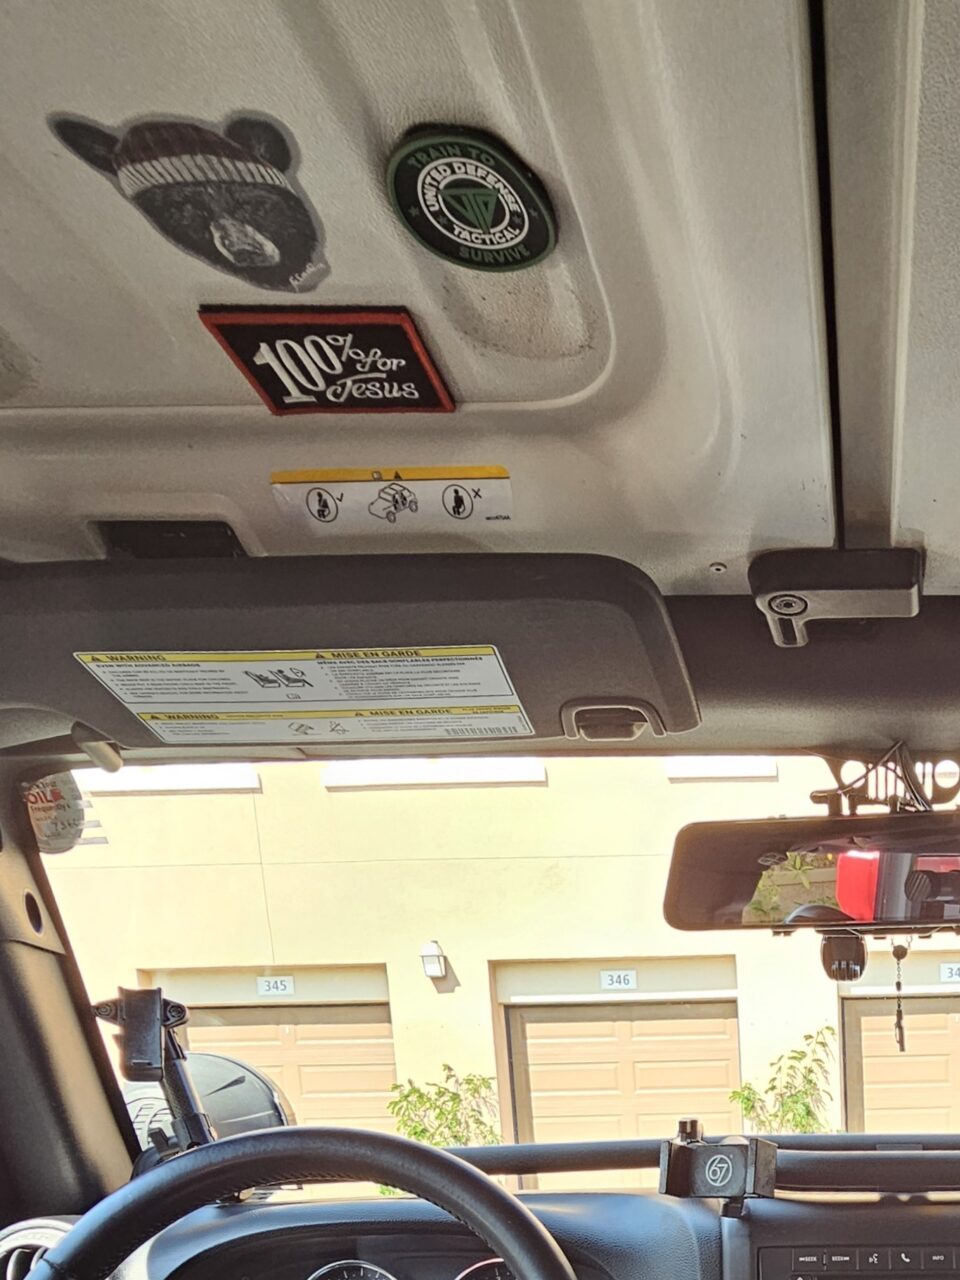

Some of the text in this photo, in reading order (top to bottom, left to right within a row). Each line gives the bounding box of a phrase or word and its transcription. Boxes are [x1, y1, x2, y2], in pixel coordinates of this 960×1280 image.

[408, 144, 496, 168] TRAIN TO
[424, 162, 521, 213] UNITED DEFENSE
[453, 224, 520, 246] TACTICAL
[459, 244, 530, 264] SURVIVE
[253, 333, 407, 404] 100% for
[326, 372, 420, 403] Jesus
[331, 651, 362, 659] MISE
[378, 650, 421, 658] GARDE
[264, 979, 287, 992] 345
[608, 974, 630, 986] 346
